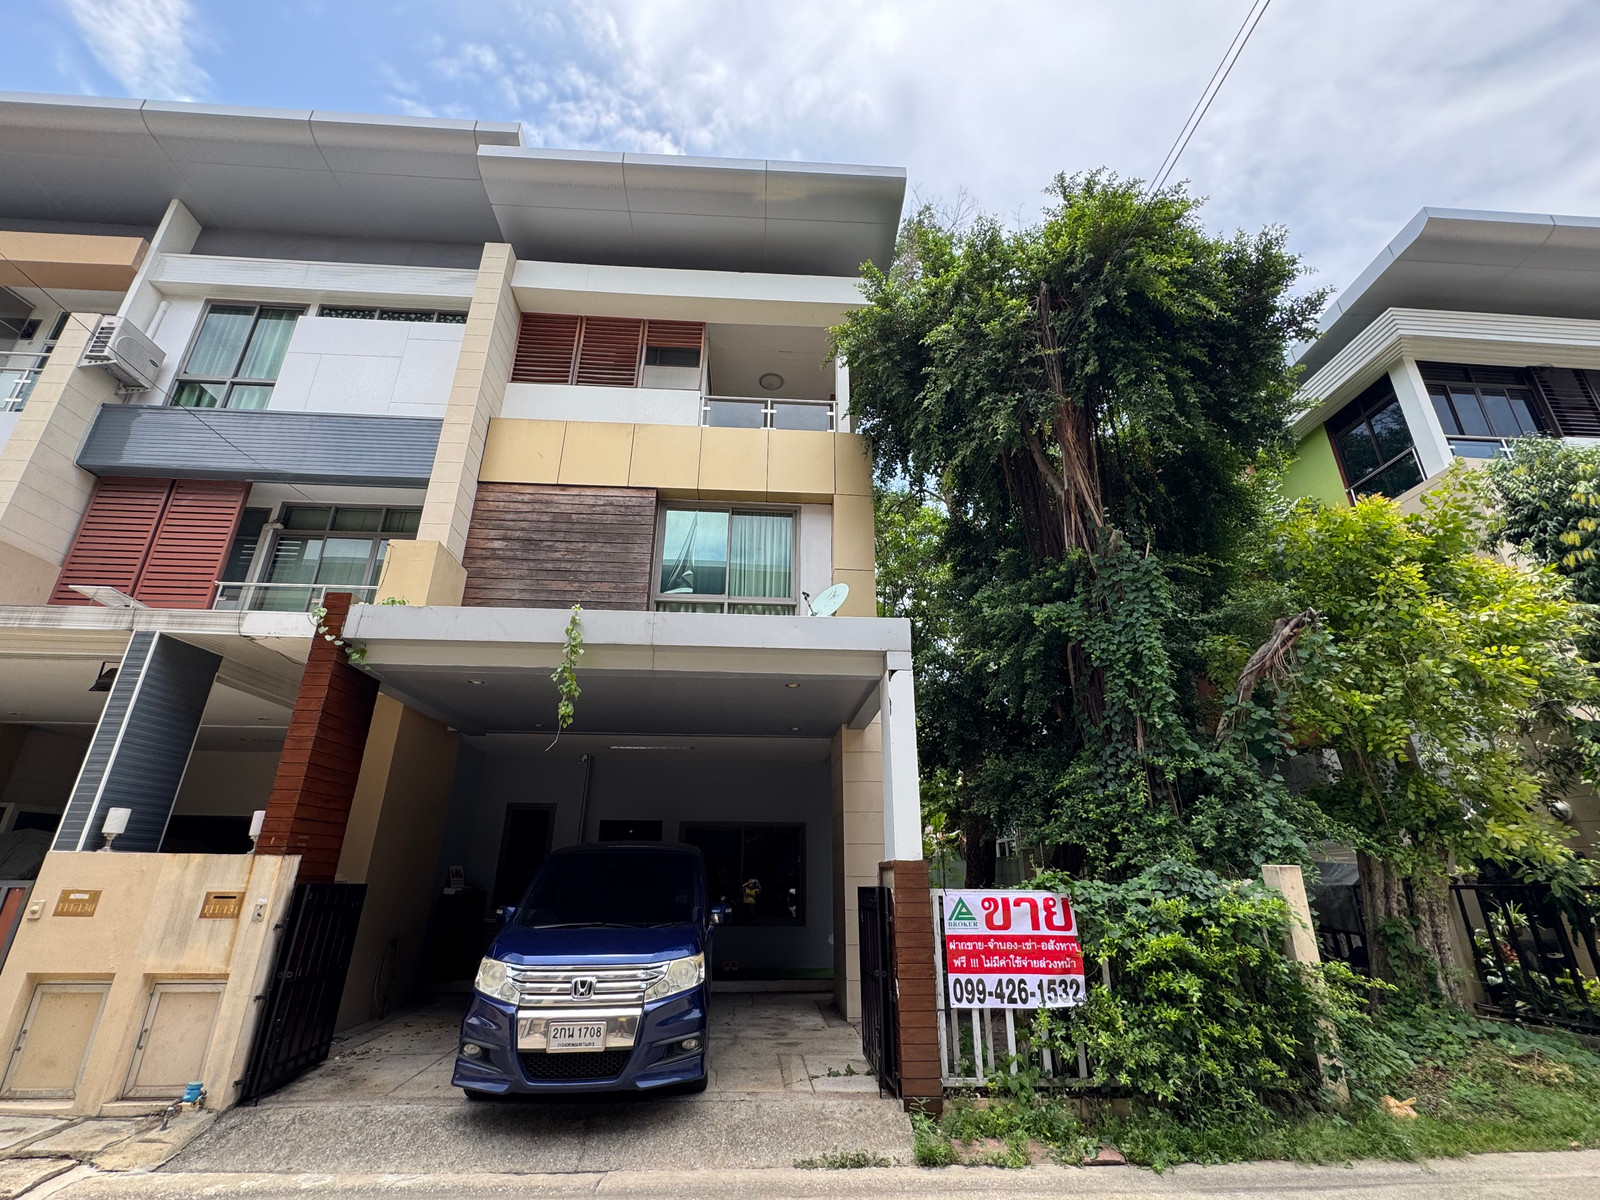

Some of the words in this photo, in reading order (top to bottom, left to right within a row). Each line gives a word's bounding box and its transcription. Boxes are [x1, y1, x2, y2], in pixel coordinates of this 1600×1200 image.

[204, 904, 239, 914] 111/131
[981, 897, 1073, 931] ขาย
[953, 955, 966, 968] ฟรี
[970, 958, 979, 968] !!!
[981, 954, 1077, 969] ไม่มีค่าใช้จ่ายล่วงหน้า
[953, 978, 1082, 1005] 099-426-1532
[578, 1026, 602, 1038] 1708
